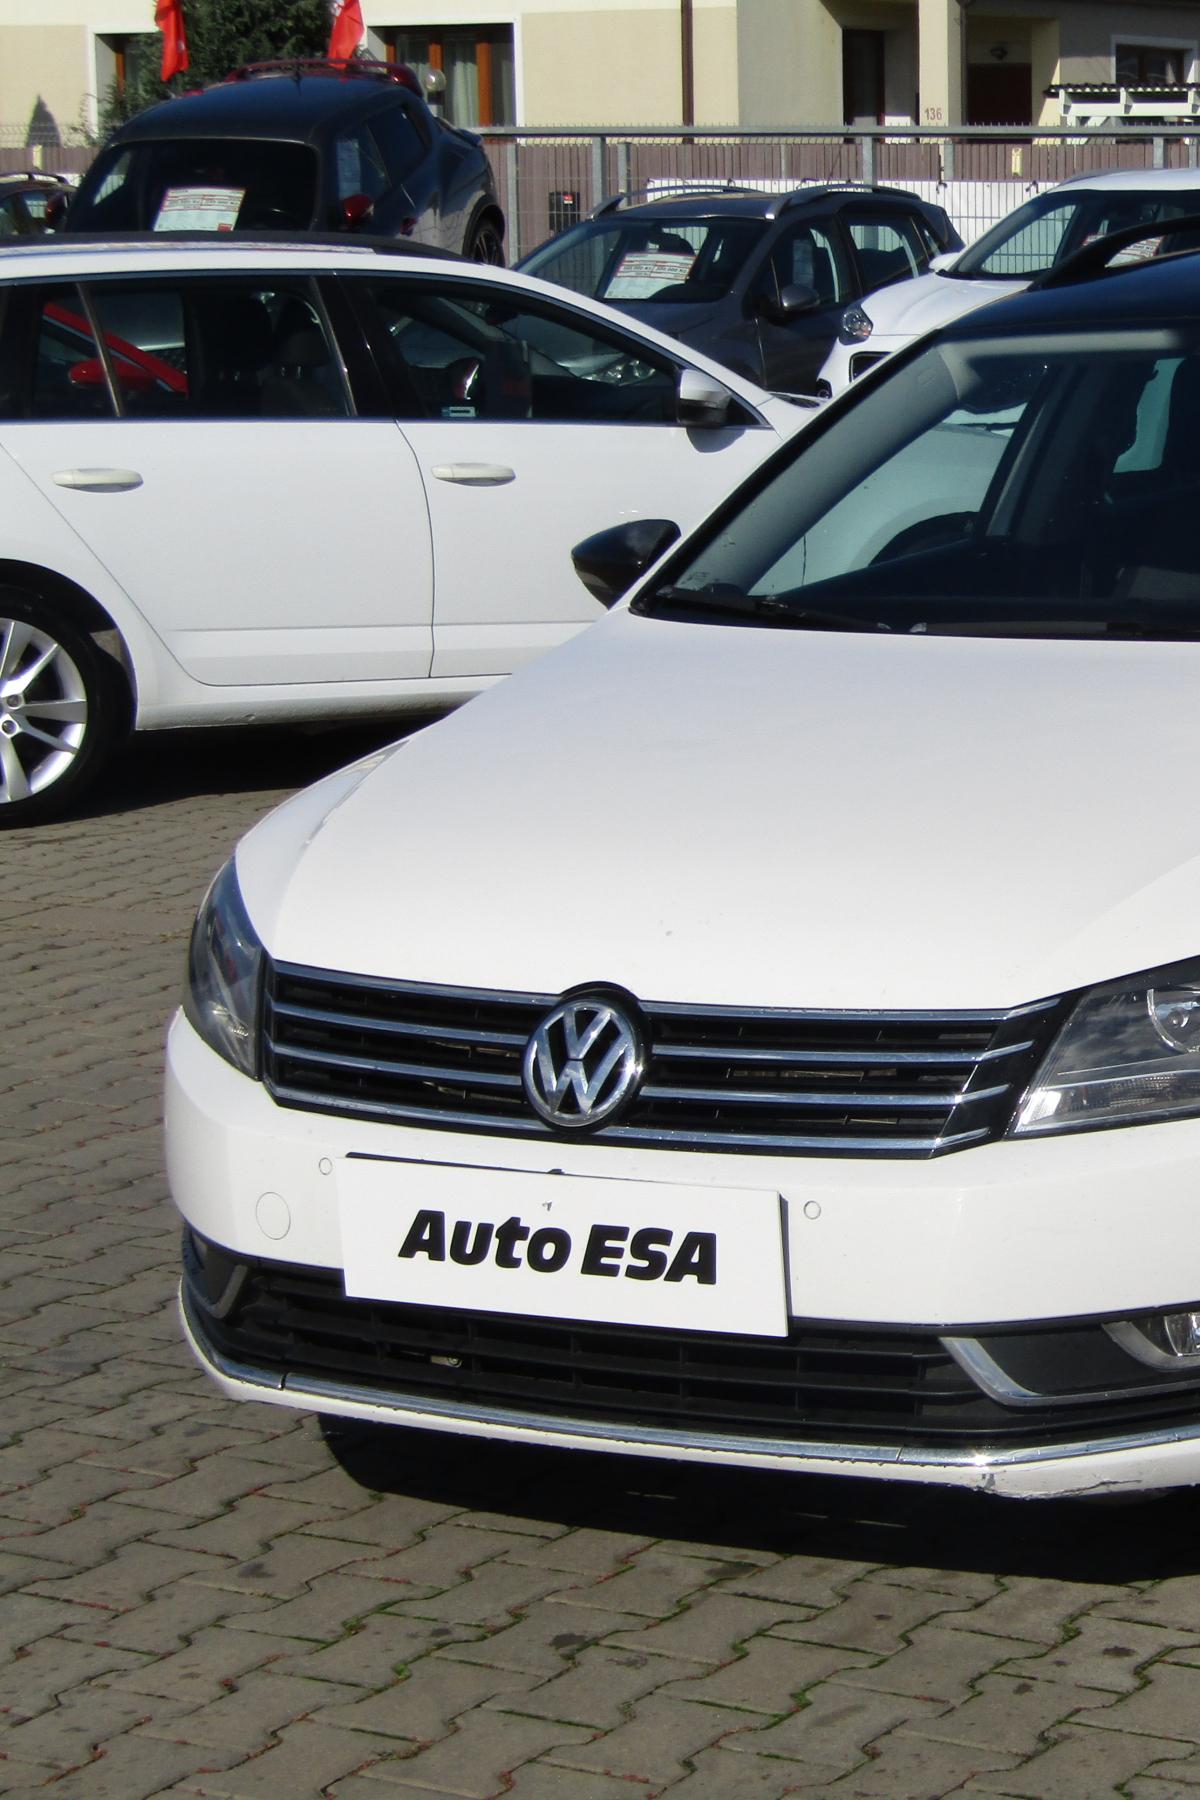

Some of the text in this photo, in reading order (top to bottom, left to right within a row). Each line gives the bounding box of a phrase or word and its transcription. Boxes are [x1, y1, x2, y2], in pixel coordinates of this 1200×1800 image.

[924, 107, 942, 121] 136
[524, 998, 637, 1127] VW
[398, 1209, 717, 1286] Auto ESA
